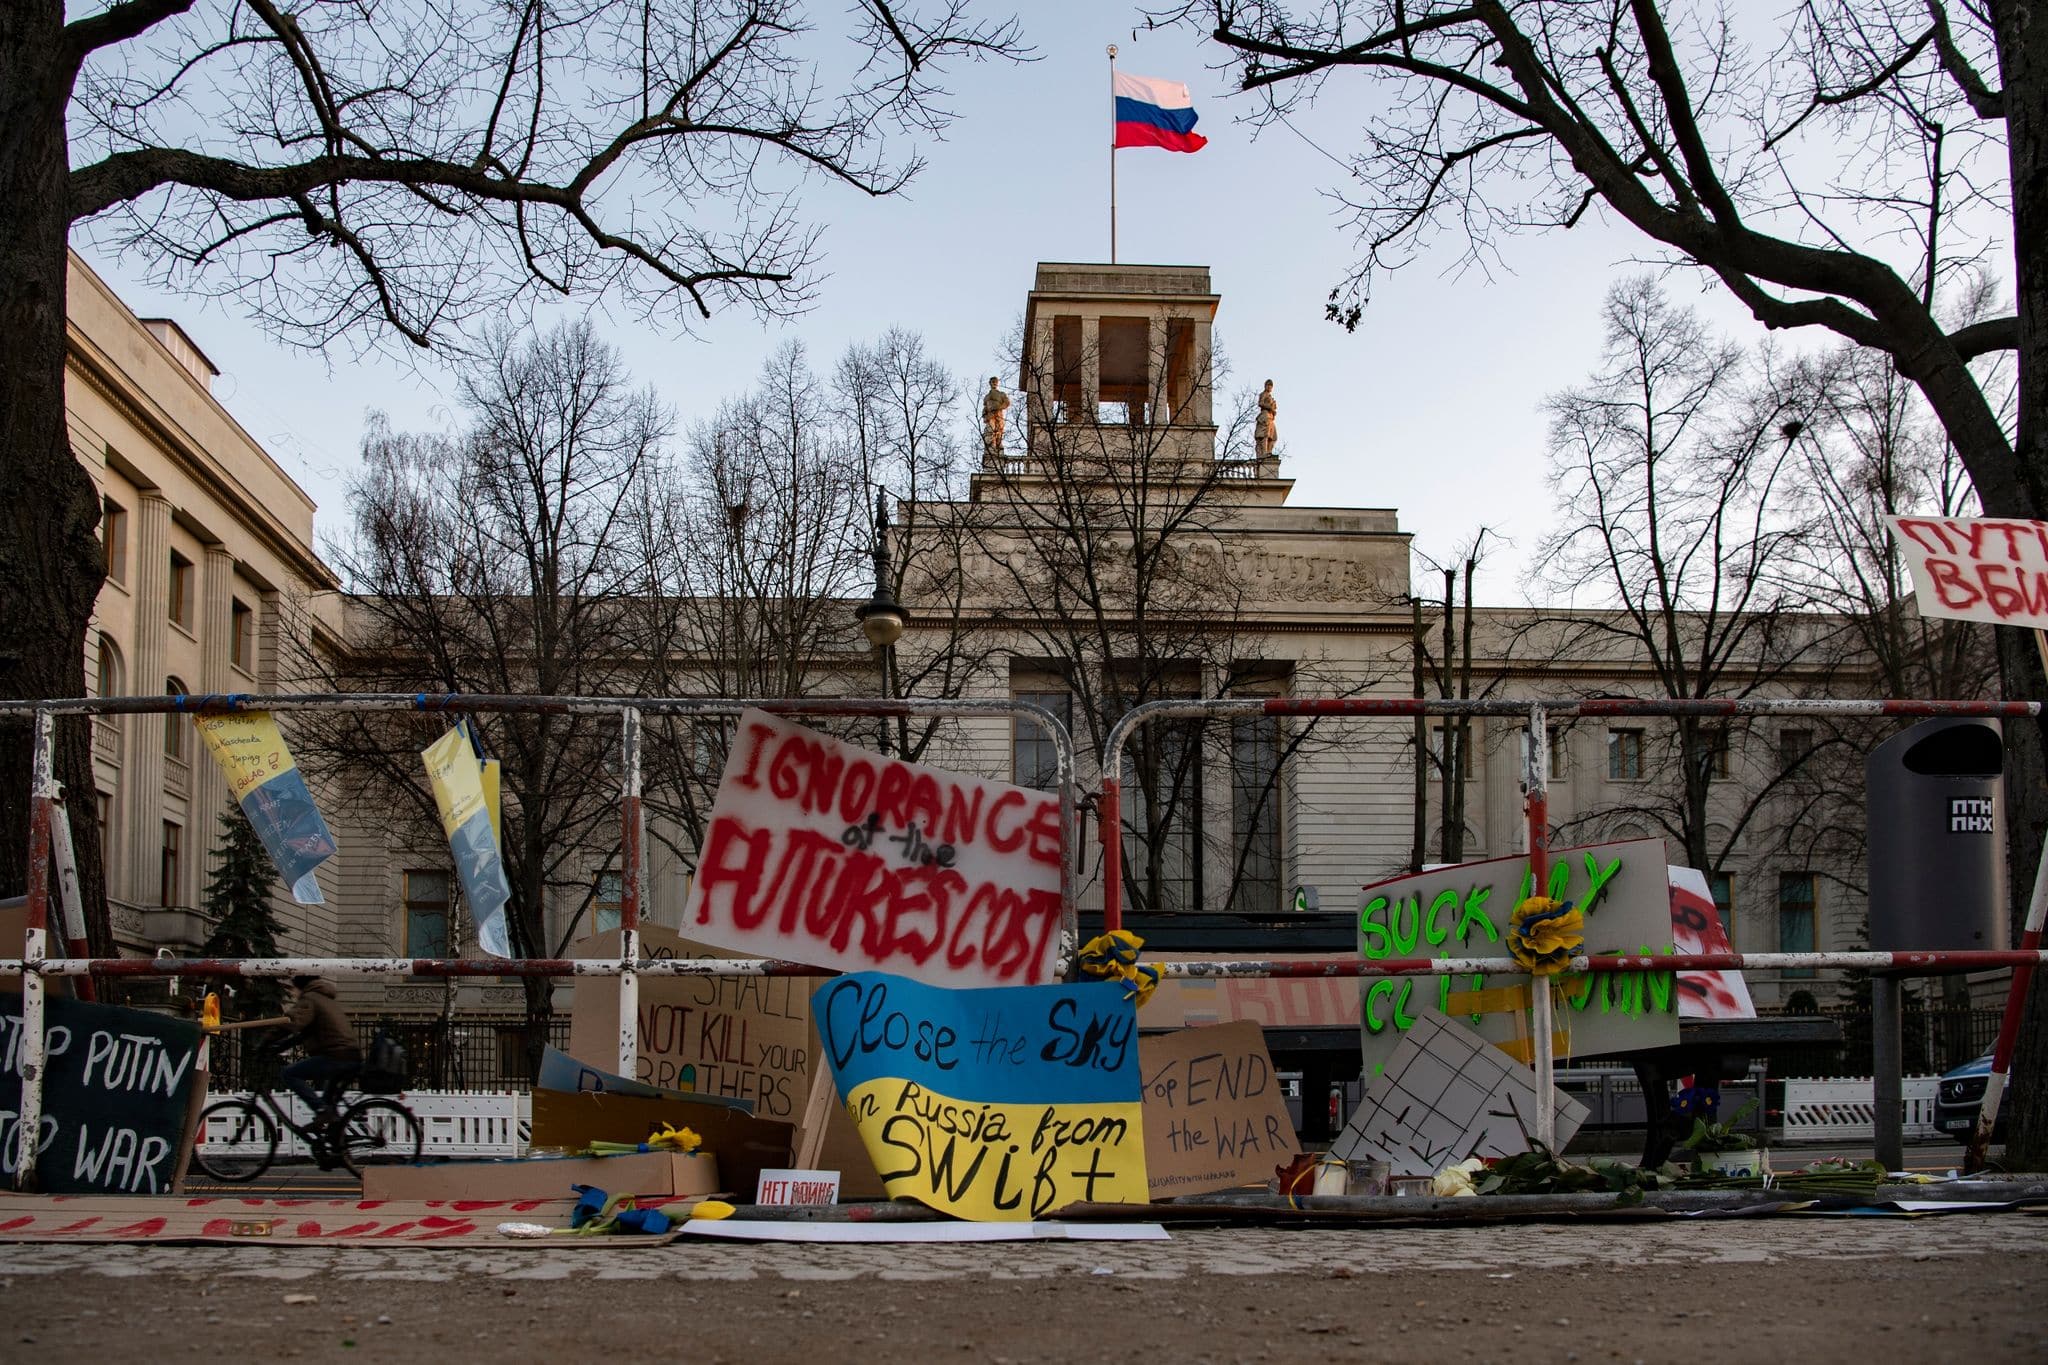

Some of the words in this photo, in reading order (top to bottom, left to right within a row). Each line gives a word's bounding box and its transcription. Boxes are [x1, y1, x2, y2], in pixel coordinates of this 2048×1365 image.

[731, 722, 1061, 867] IGNORANCE
[1952, 800, 1992, 815] ПТН
[1952, 816, 1993, 831] ПНХ
[889, 822, 956, 867] the
[947, 882, 1061, 985] COST
[1360, 887, 1499, 961] SUCK
[638, 1004, 693, 1056] NOT
[700, 1011, 754, 1067] KILL
[758, 1043, 806, 1075] YOUR
[827, 980, 959, 1071] Close
[970, 1008, 1027, 1065] the
[1188, 1053, 1267, 1106] END
[895, 1081, 1011, 1142] Russia
[1031, 1106, 1127, 1158] from
[1167, 1119, 1209, 1153] the
[1214, 1114, 1288, 1160] WAR
[761, 1180, 789, 1205] НЕТ
